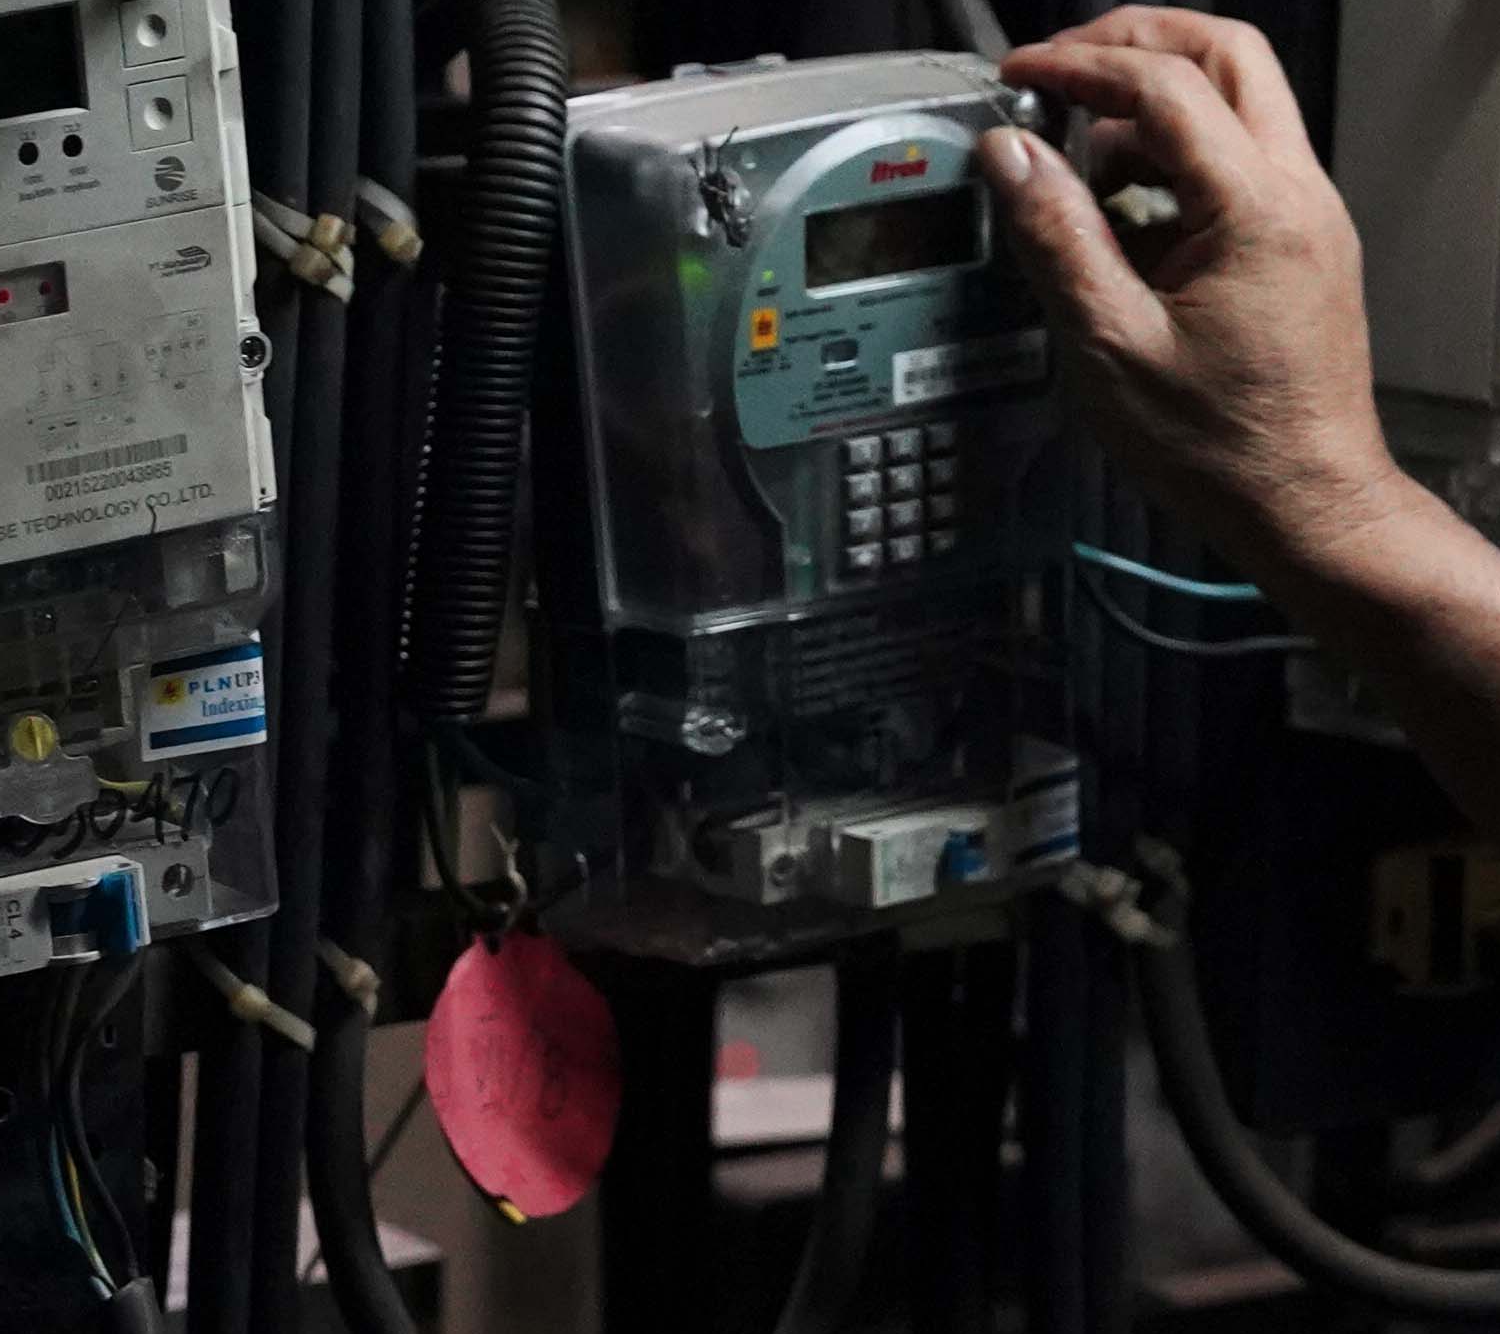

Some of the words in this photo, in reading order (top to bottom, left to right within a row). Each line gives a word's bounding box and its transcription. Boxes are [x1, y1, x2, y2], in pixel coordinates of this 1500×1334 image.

[145, 189, 198, 208] SUNRISE
[23, 498, 140, 535] TECHNOLOGY
[188, 676, 232, 695] PLN
